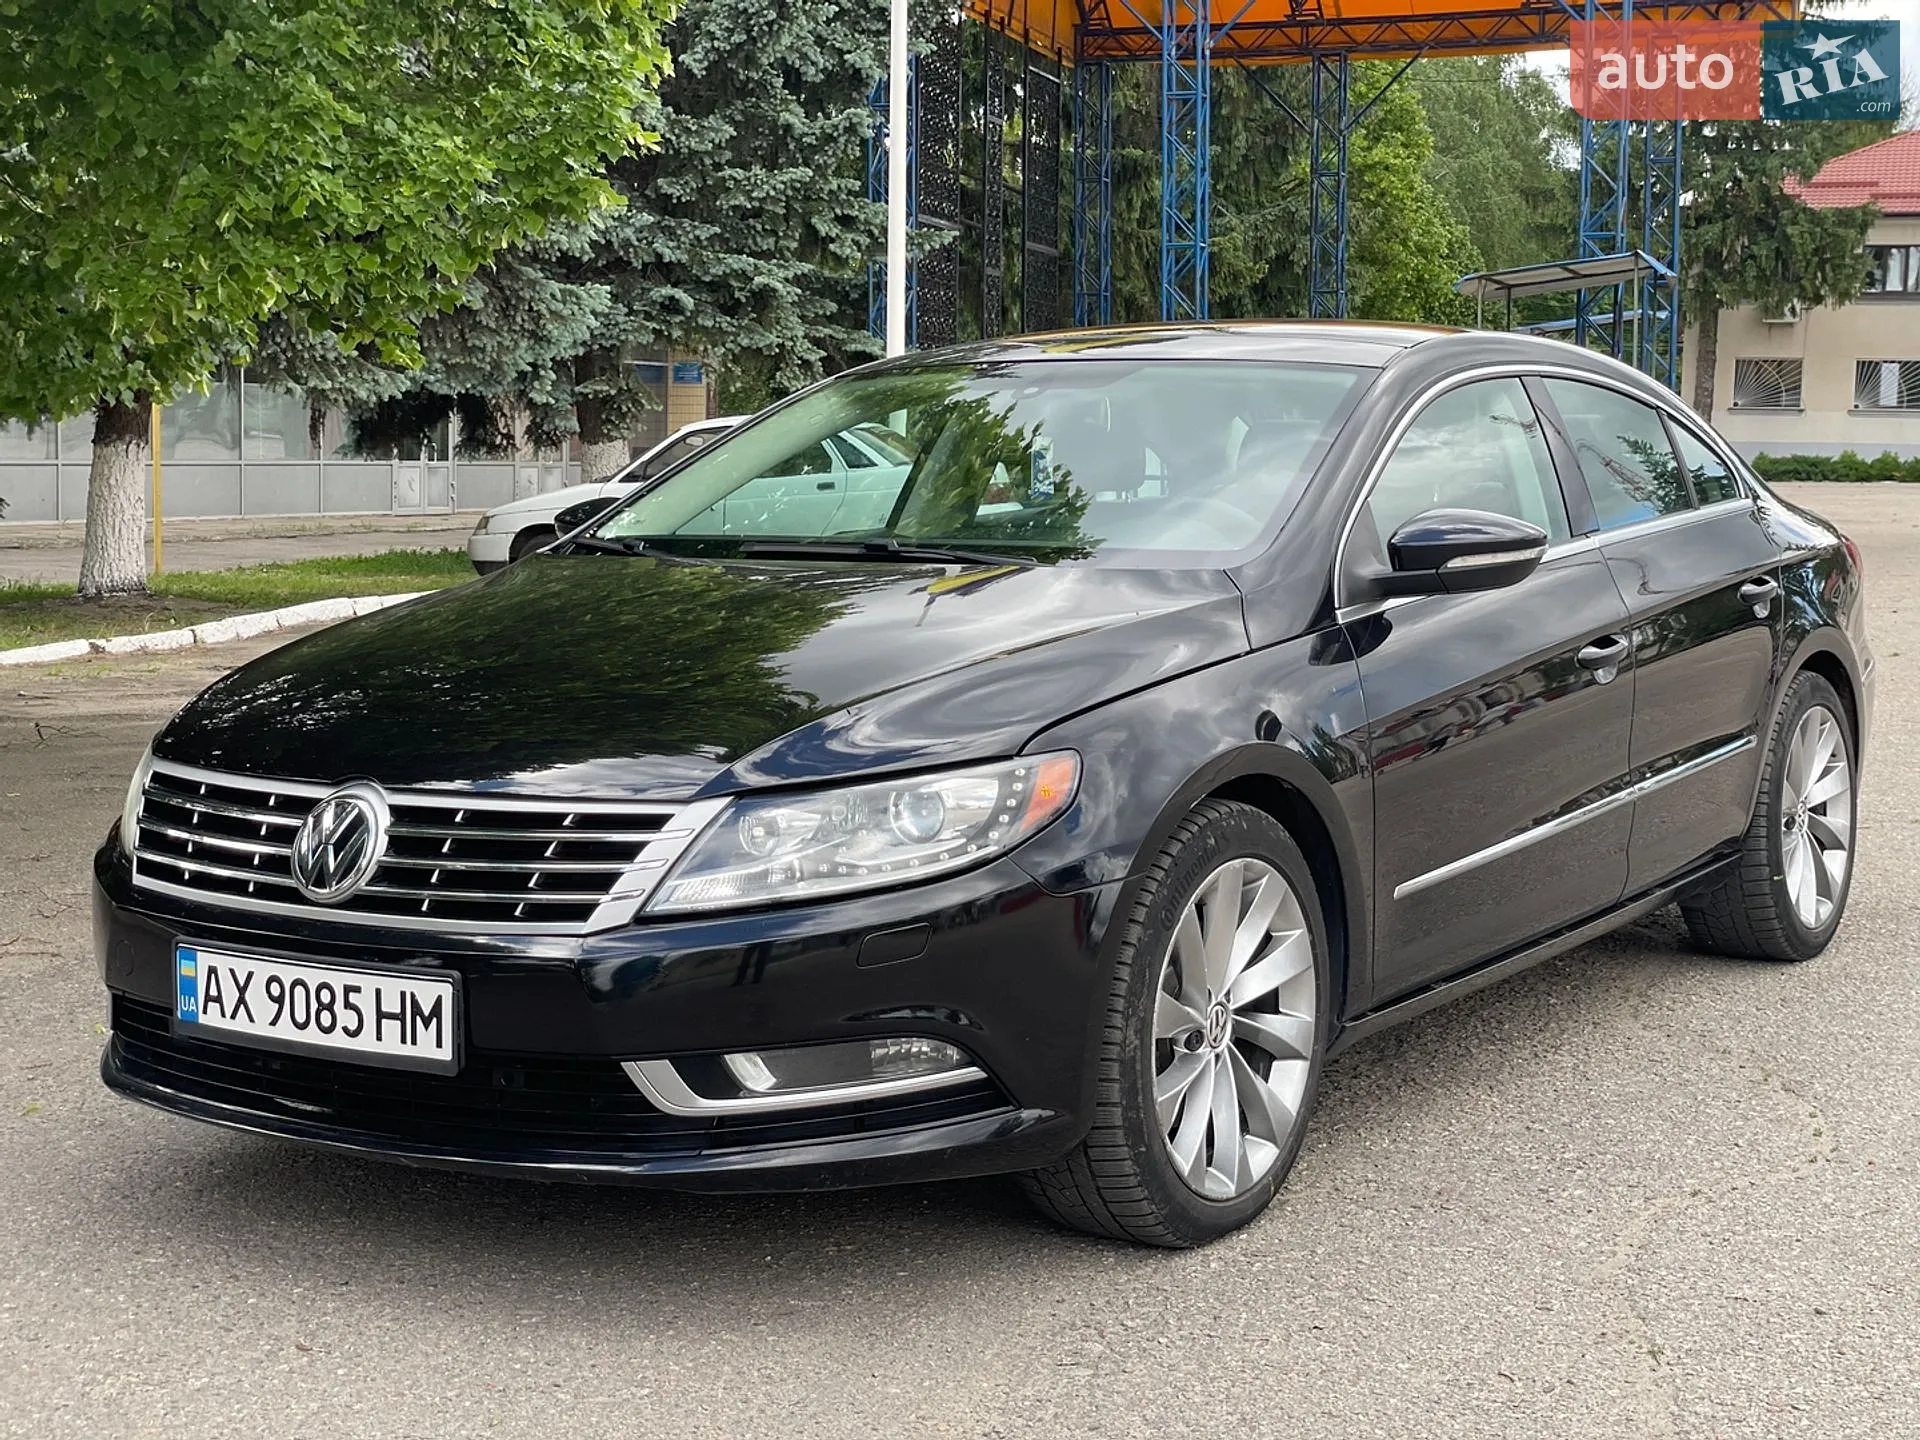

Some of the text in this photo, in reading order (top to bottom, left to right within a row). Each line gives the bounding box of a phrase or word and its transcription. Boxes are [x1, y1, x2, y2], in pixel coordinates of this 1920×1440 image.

[181, 993, 197, 1013] UA
[202, 965, 443, 1049] AX 9085 HM
